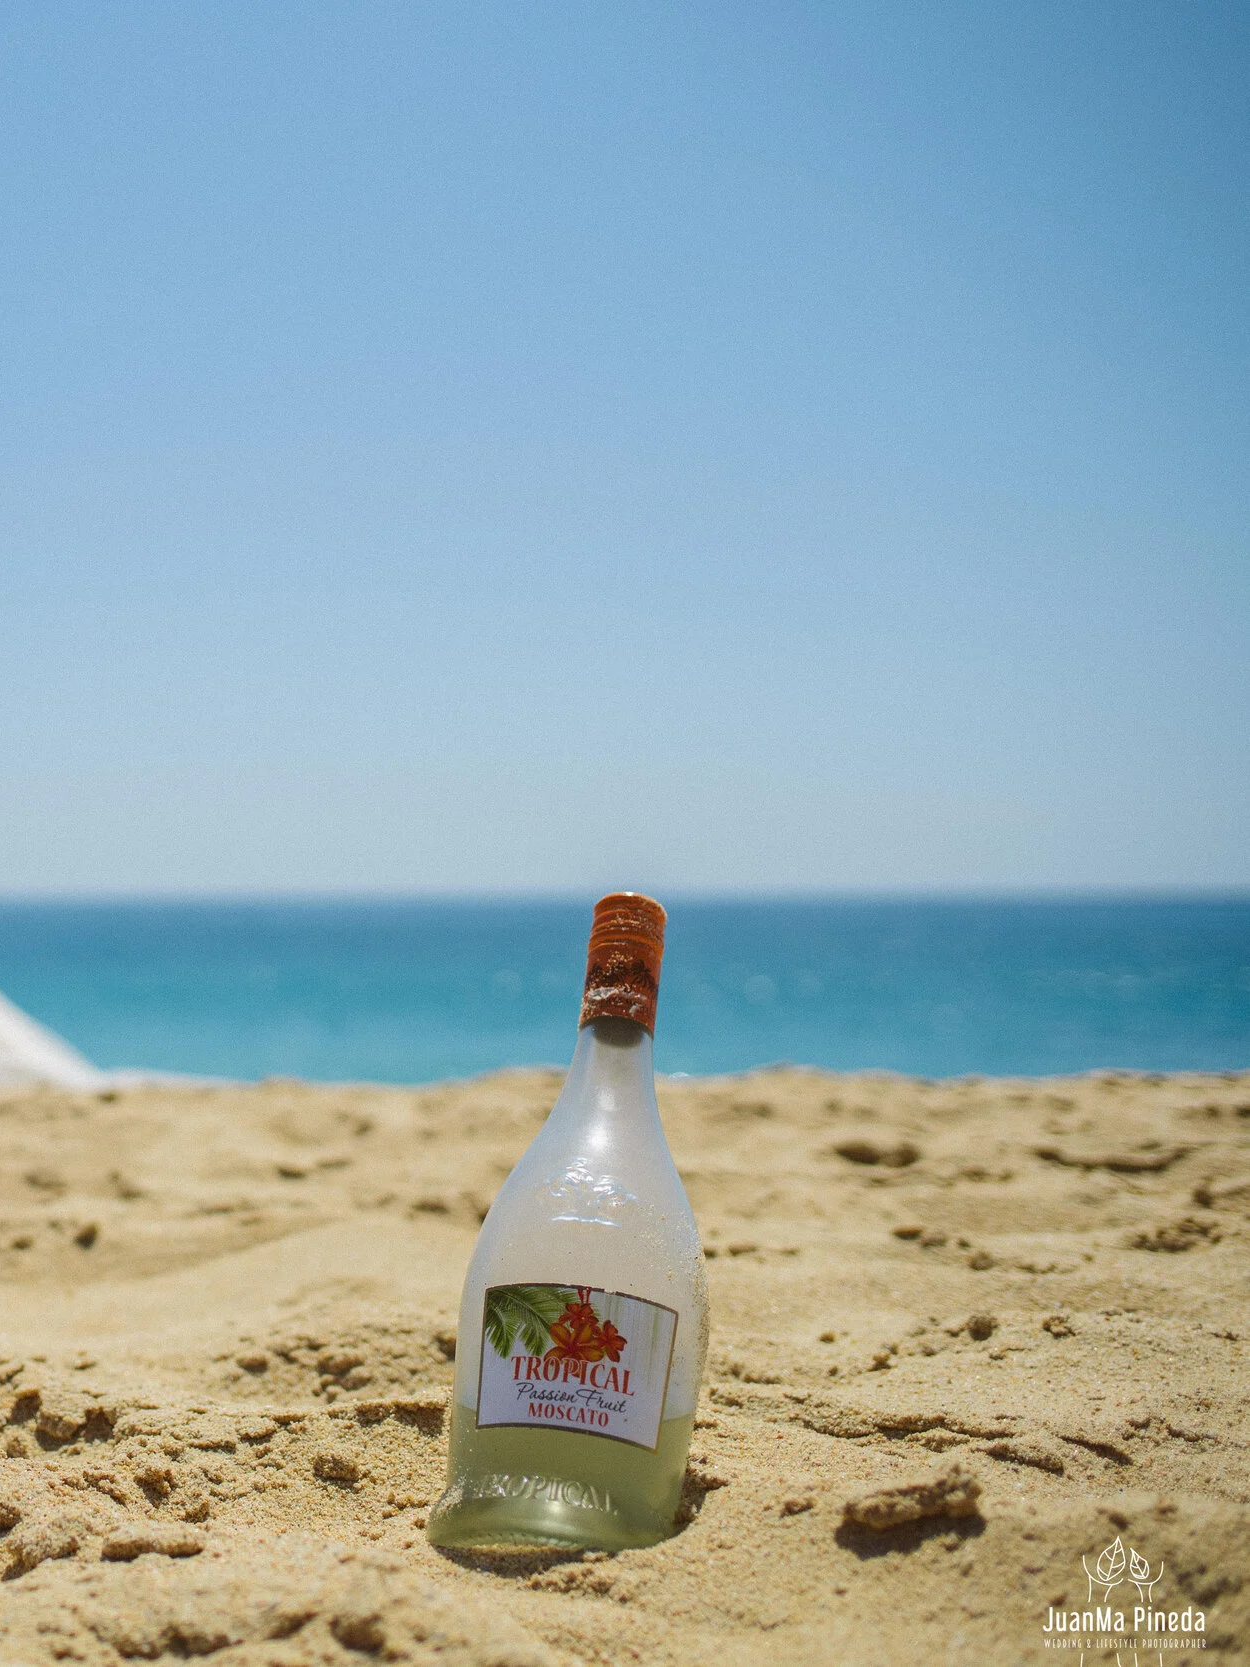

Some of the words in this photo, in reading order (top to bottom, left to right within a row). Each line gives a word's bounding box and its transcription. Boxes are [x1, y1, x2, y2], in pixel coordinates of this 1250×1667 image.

[511, 1355, 635, 1396] TROPICAL
[516, 1382, 578, 1402] Passion
[577, 1388, 627, 1413] Fruit
[527, 1402, 609, 1427] MOSCATO
